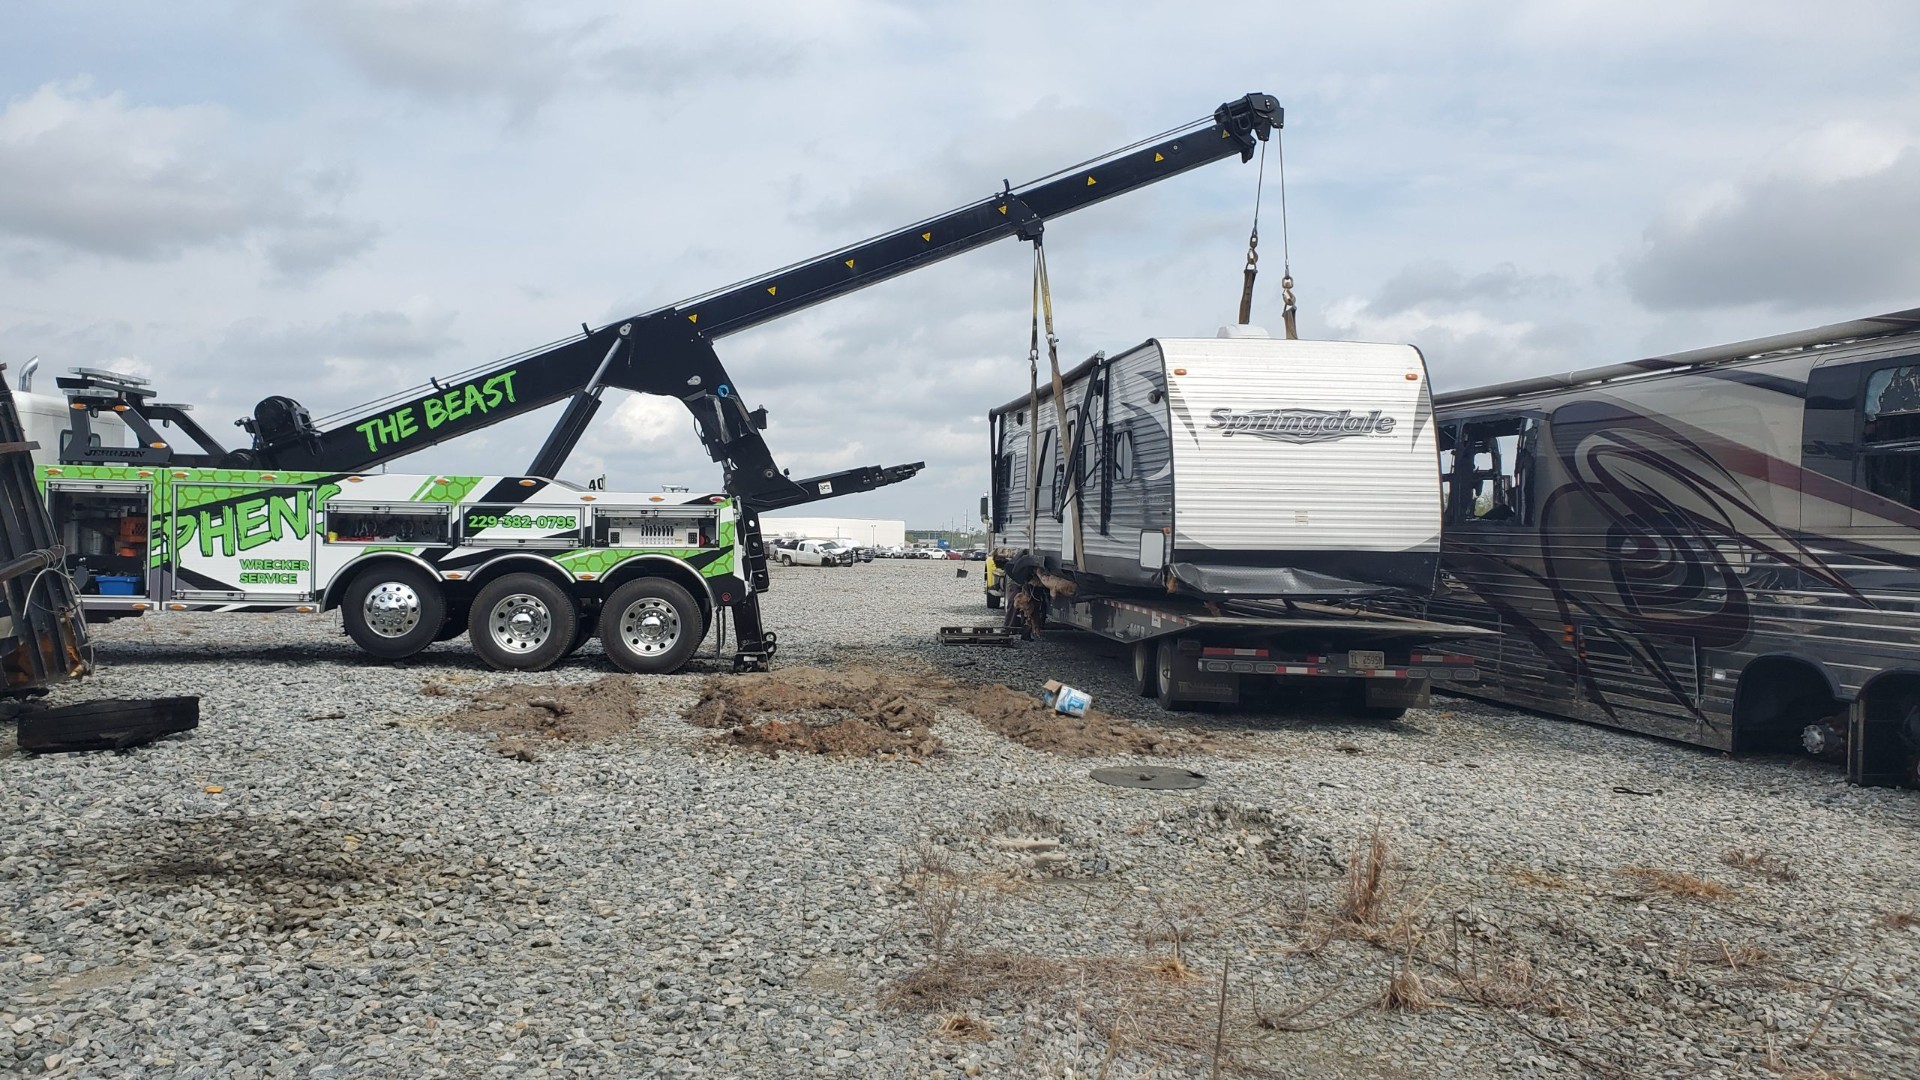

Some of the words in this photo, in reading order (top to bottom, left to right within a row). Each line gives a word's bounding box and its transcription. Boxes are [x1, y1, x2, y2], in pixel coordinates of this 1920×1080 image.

[356, 408, 418, 452] THE
[423, 370, 516, 429] BEAST
[1206, 408, 1396, 437] Springdale
[468, 515, 576, 529] 229-382-0795
[239, 559, 309, 571] WRECKER
[239, 573, 298, 585] SERVICE
